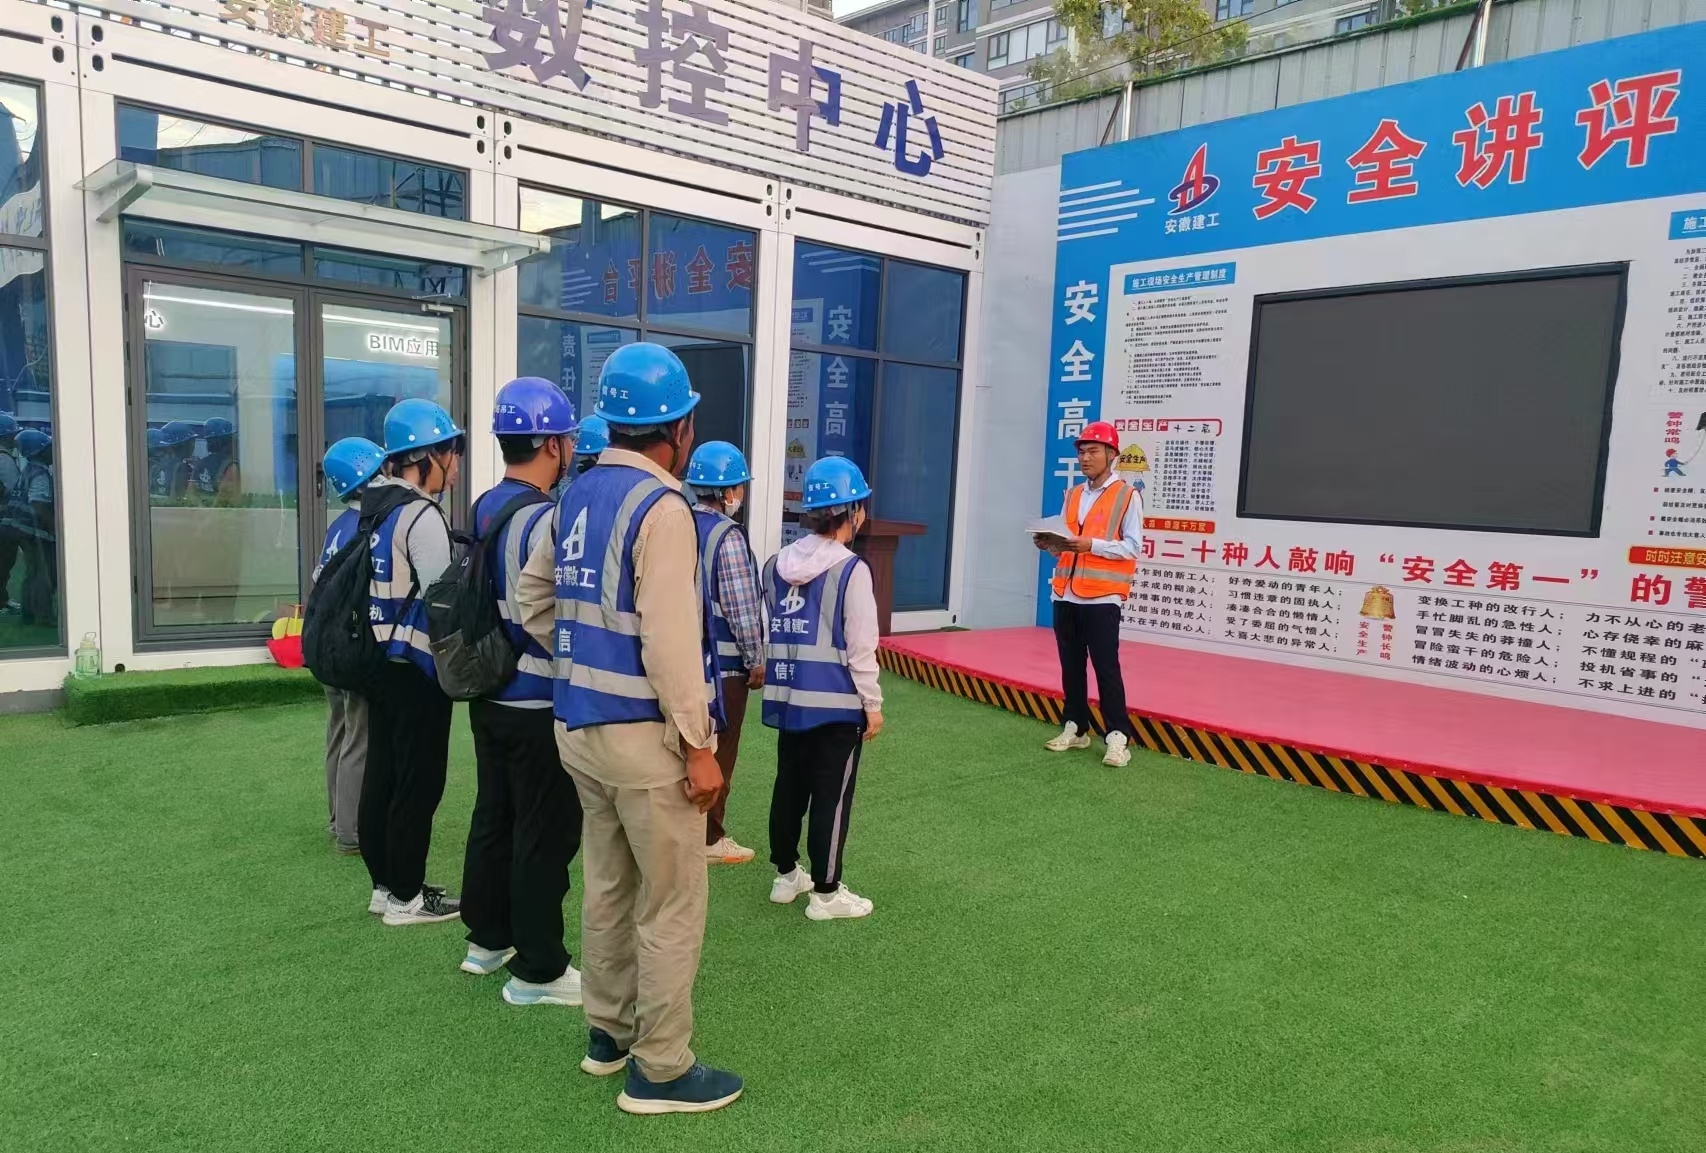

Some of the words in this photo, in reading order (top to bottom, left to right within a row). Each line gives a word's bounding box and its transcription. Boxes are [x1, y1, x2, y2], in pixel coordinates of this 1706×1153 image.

[482, 0, 945, 177] 数控中心
[1253, 69, 1681, 221] 安全讲评
[1164, 212, 1220, 235] 安徽建工
[1132, 268, 1227, 289] 施工现场安全生产管理制度
[369, 334, 439, 357] BIM应用
[1120, 453, 1146, 464] 安全生产
[1356, 620, 1369, 656] 安全生产
[1379, 623, 1393, 660] 警钟长鸣
[1579, 661, 1706, 688] 投机省事的“
